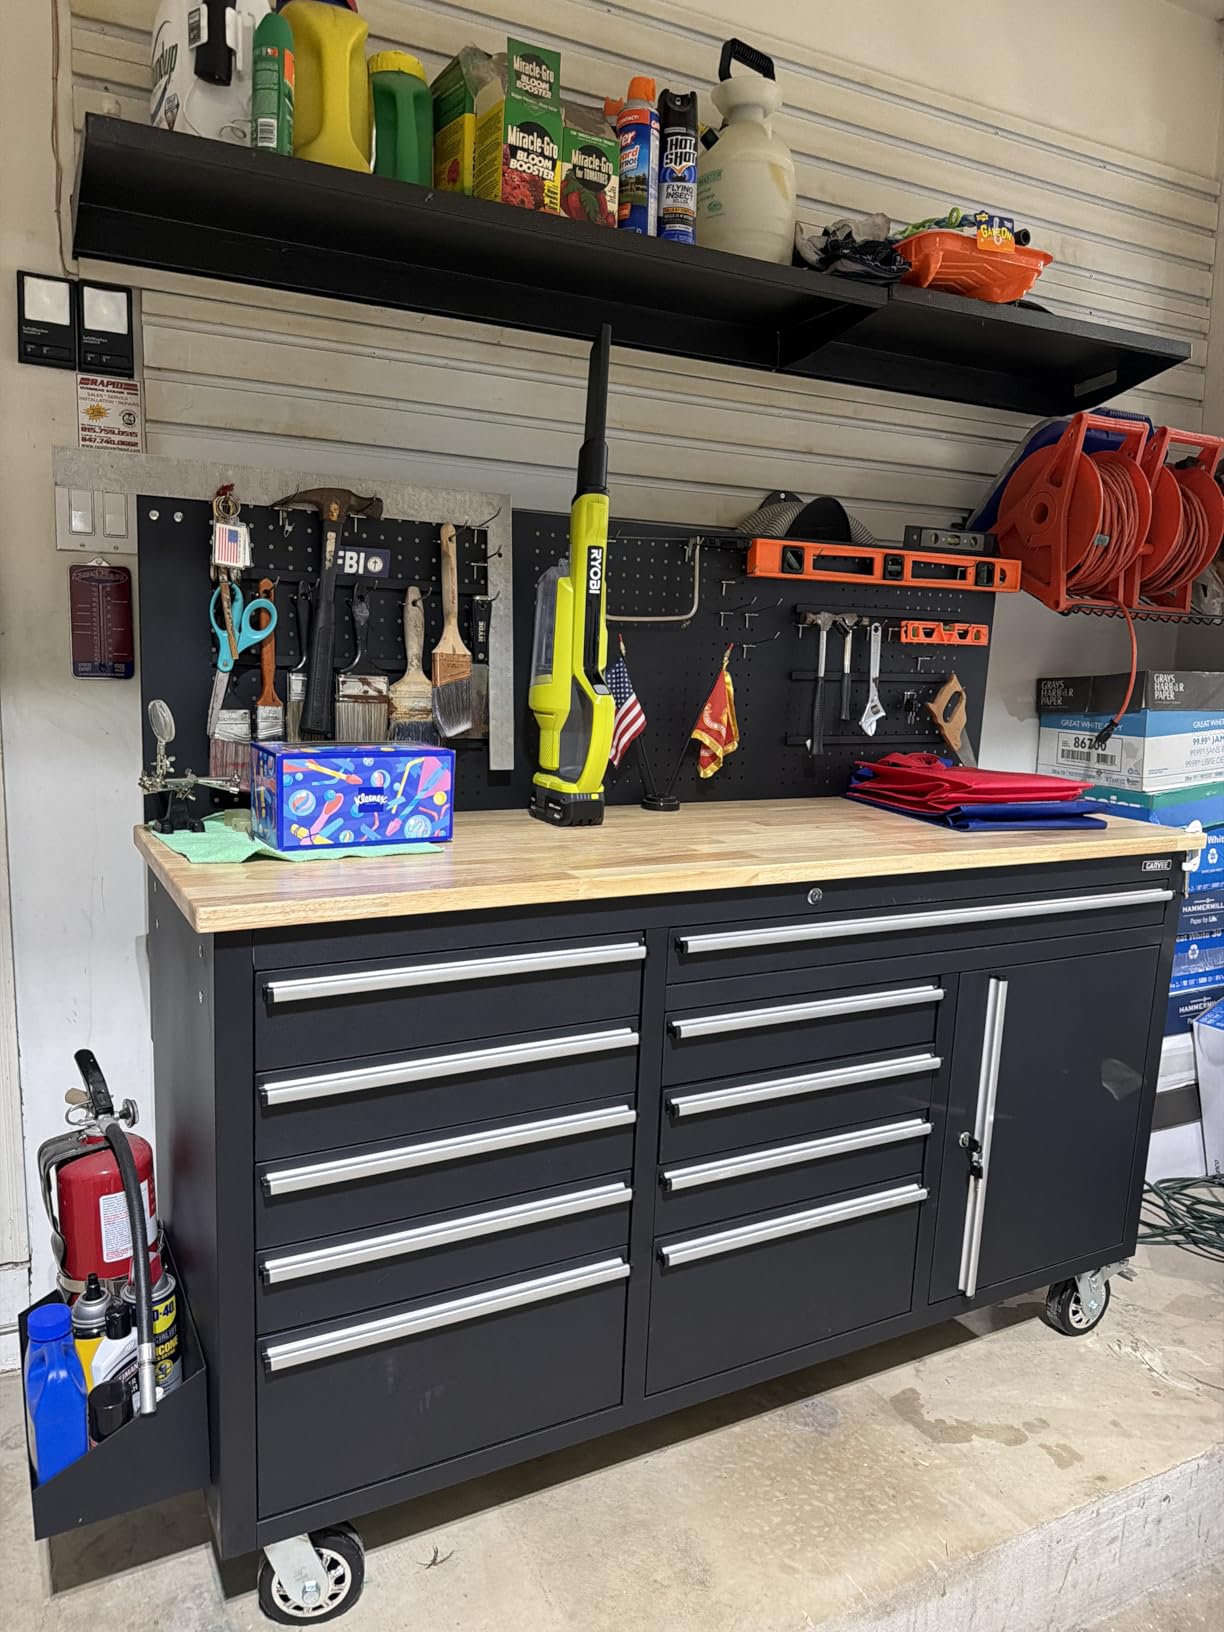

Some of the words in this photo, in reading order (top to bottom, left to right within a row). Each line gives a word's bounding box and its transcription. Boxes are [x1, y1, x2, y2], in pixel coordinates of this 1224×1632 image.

[513, 55, 554, 83] Miracle-Gro
[521, 74, 550, 90] BLOOM
[516, 80, 552, 99] BOOSTER
[507, 124, 558, 159] Miracle-Gro
[667, 135, 695, 153] HOT
[516, 150, 552, 170] BLOOM
[571, 149, 614, 175] Miracle-Gro
[664, 150, 697, 168] SHOT
[509, 158, 554, 181] BOOSTER
[666, 184, 694, 194] FLYING
[666, 191, 694, 201] INSECT
[90, 378, 124, 389] RAPID
[588, 548, 602, 594] RYOBI
[478, 620, 486, 642] HYDE
[1154, 673, 1176, 683] GRAYS
[1041, 680, 1064, 690] GRAYS
[1040, 696, 1062, 706] PAPER
[1154, 690, 1175, 700] PAPER
[1061, 719, 1080, 727] GREAT
[1080, 720, 1102, 729] WHITE
[1193, 720, 1210, 728] GREAT
[354, 793, 388, 806] Kleenex
[1146, 861, 1168, 870] GARVEE
[1182, 902, 1224, 913] HAMMERMILL
[1189, 931, 1210, 940] White
[152, 1302, 174, 1322] D-40
